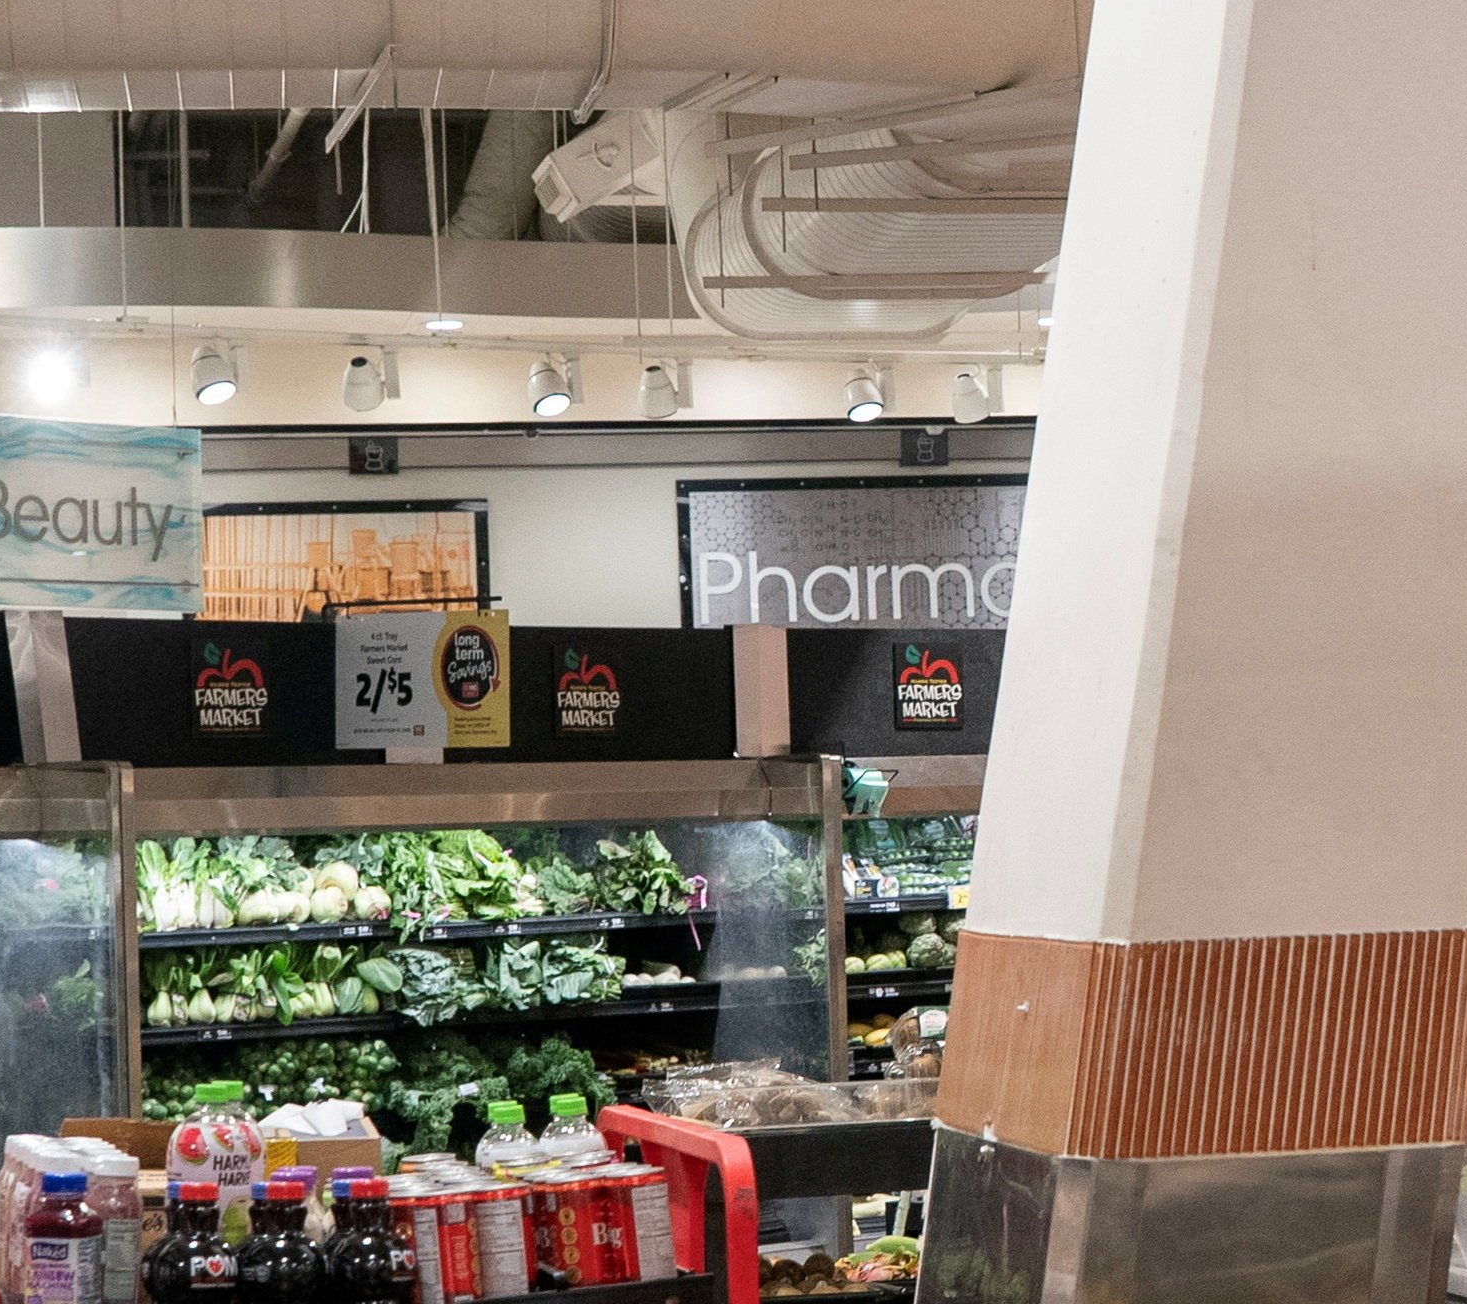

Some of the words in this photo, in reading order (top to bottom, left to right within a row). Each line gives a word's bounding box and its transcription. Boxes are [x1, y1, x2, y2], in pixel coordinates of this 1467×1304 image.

[454, 633, 480, 649] long
[455, 646, 484, 661] term
[447, 658, 494, 683] Savings
[195, 688, 268, 707] FARMERS
[356, 667, 413, 714] 2/$5
[898, 684, 962, 702] FARMERS
[557, 691, 620, 709] FARMERS
[200, 708, 263, 727] MARKET
[562, 710, 618, 727] MARKET
[902, 701, 960, 719] MARKET
[31, 1243, 68, 1260] Naked
